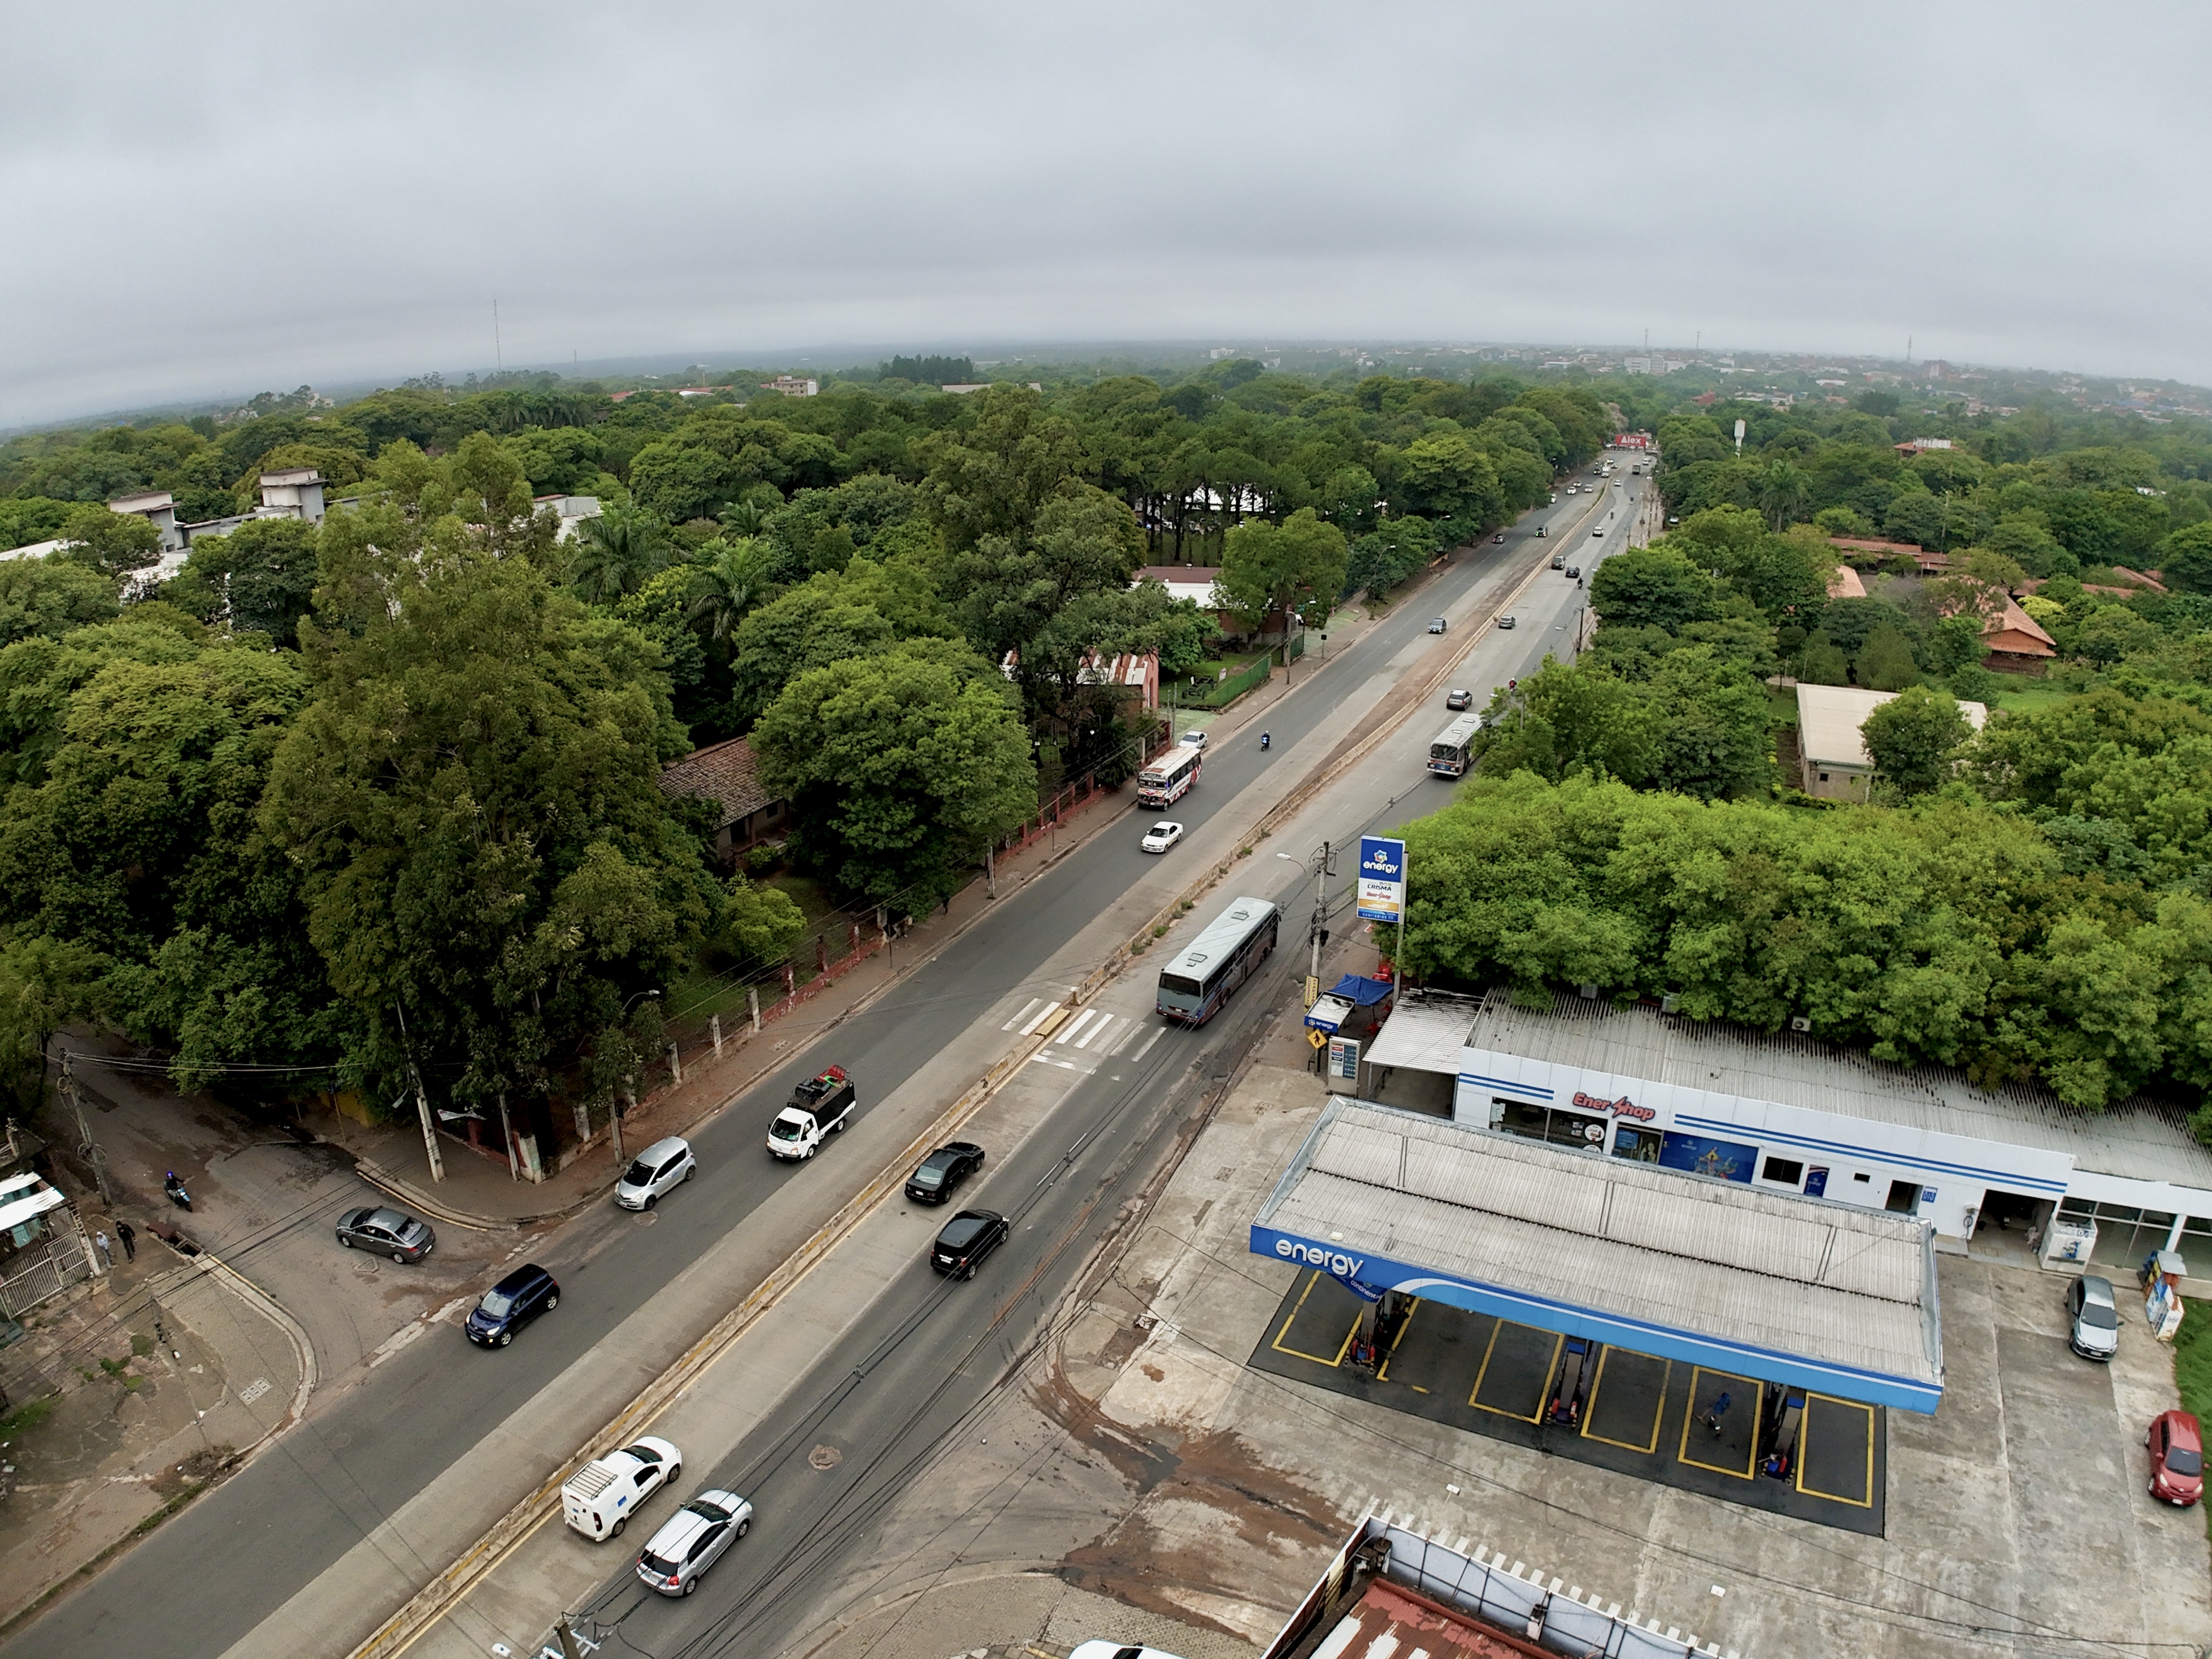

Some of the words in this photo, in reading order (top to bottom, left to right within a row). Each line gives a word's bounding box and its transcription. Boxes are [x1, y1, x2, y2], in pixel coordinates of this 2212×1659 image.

[1620, 436, 1641, 444] Alex
[1363, 861, 1398, 874] energy
[1275, 1239, 1364, 1278] energy
